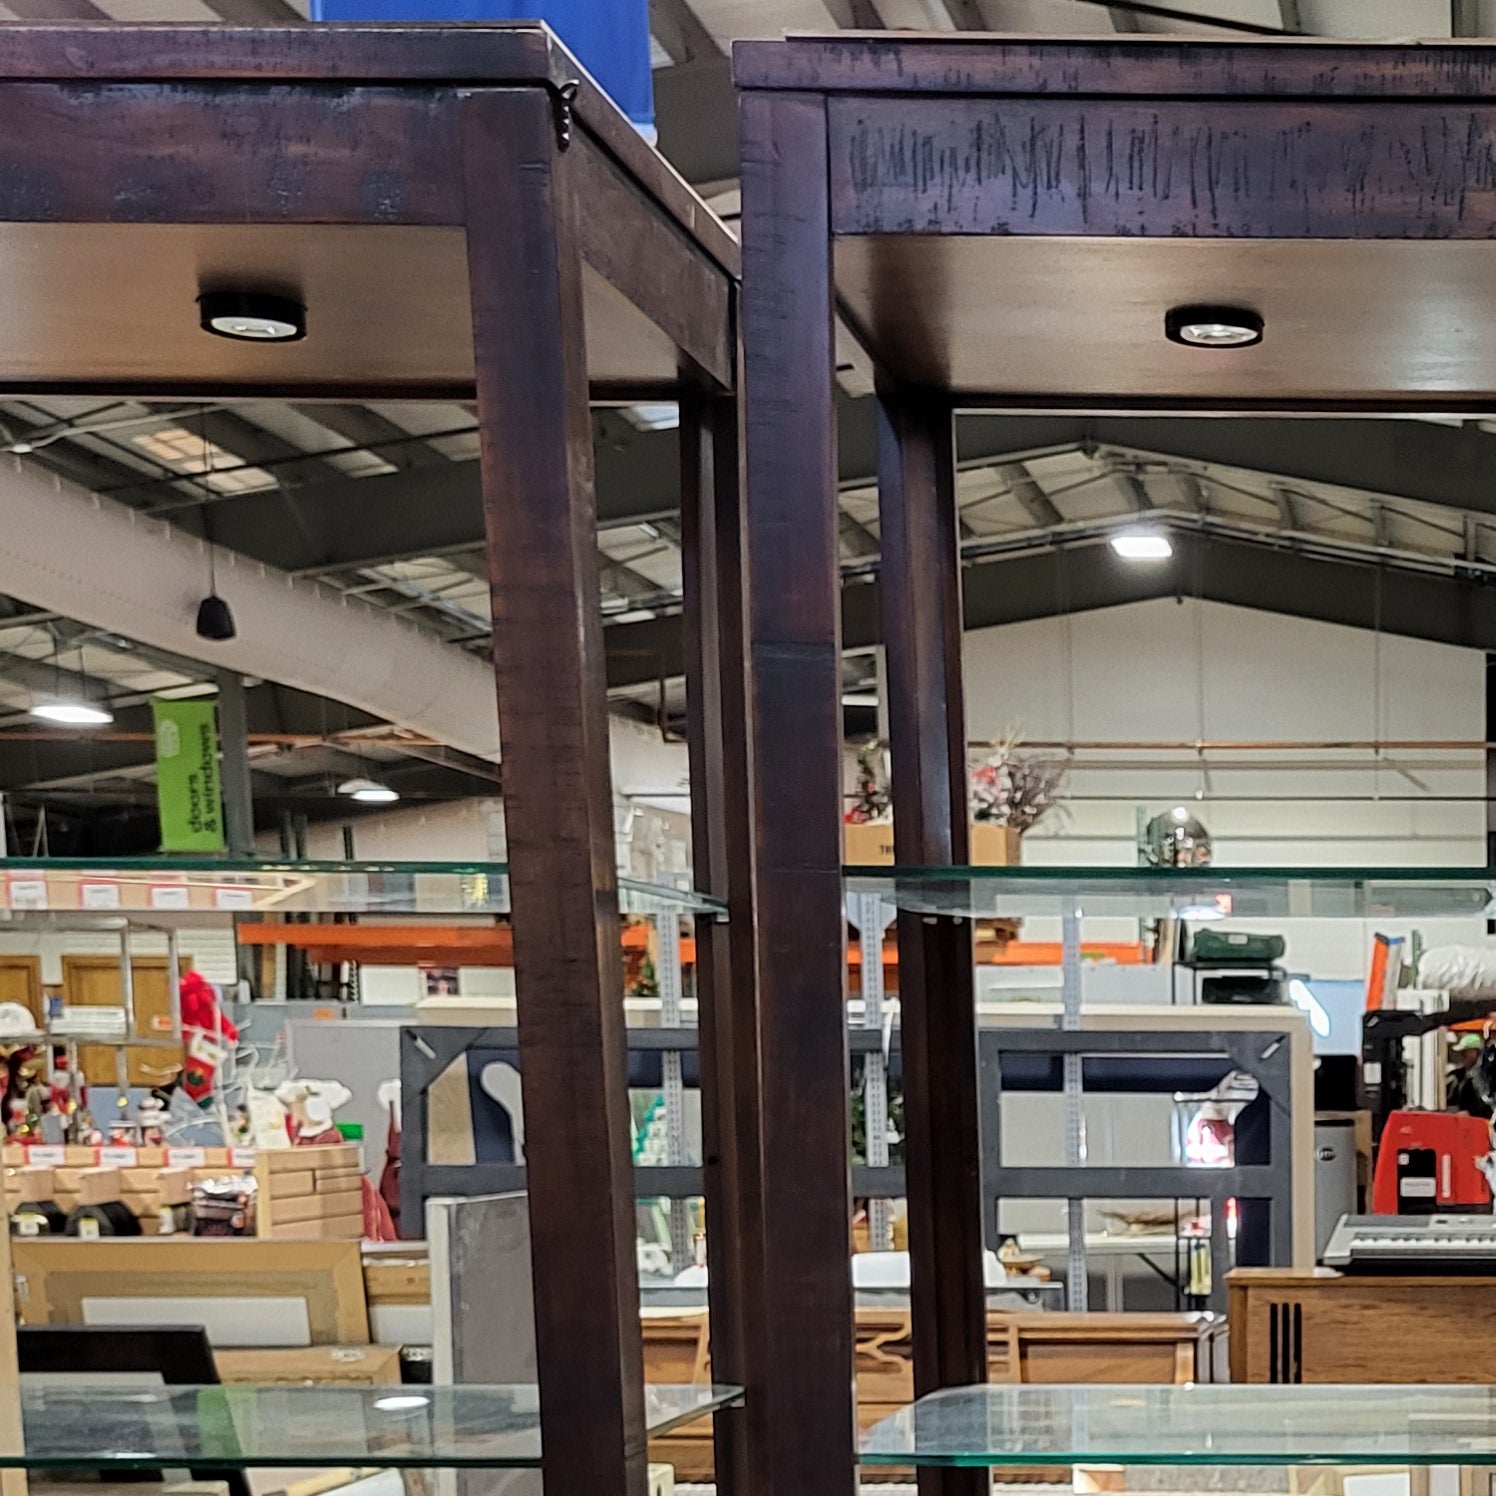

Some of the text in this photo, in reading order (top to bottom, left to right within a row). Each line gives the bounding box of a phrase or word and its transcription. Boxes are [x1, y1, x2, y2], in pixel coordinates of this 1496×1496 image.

[188, 773, 202, 833] doors
[199, 723, 217, 832] & windows
